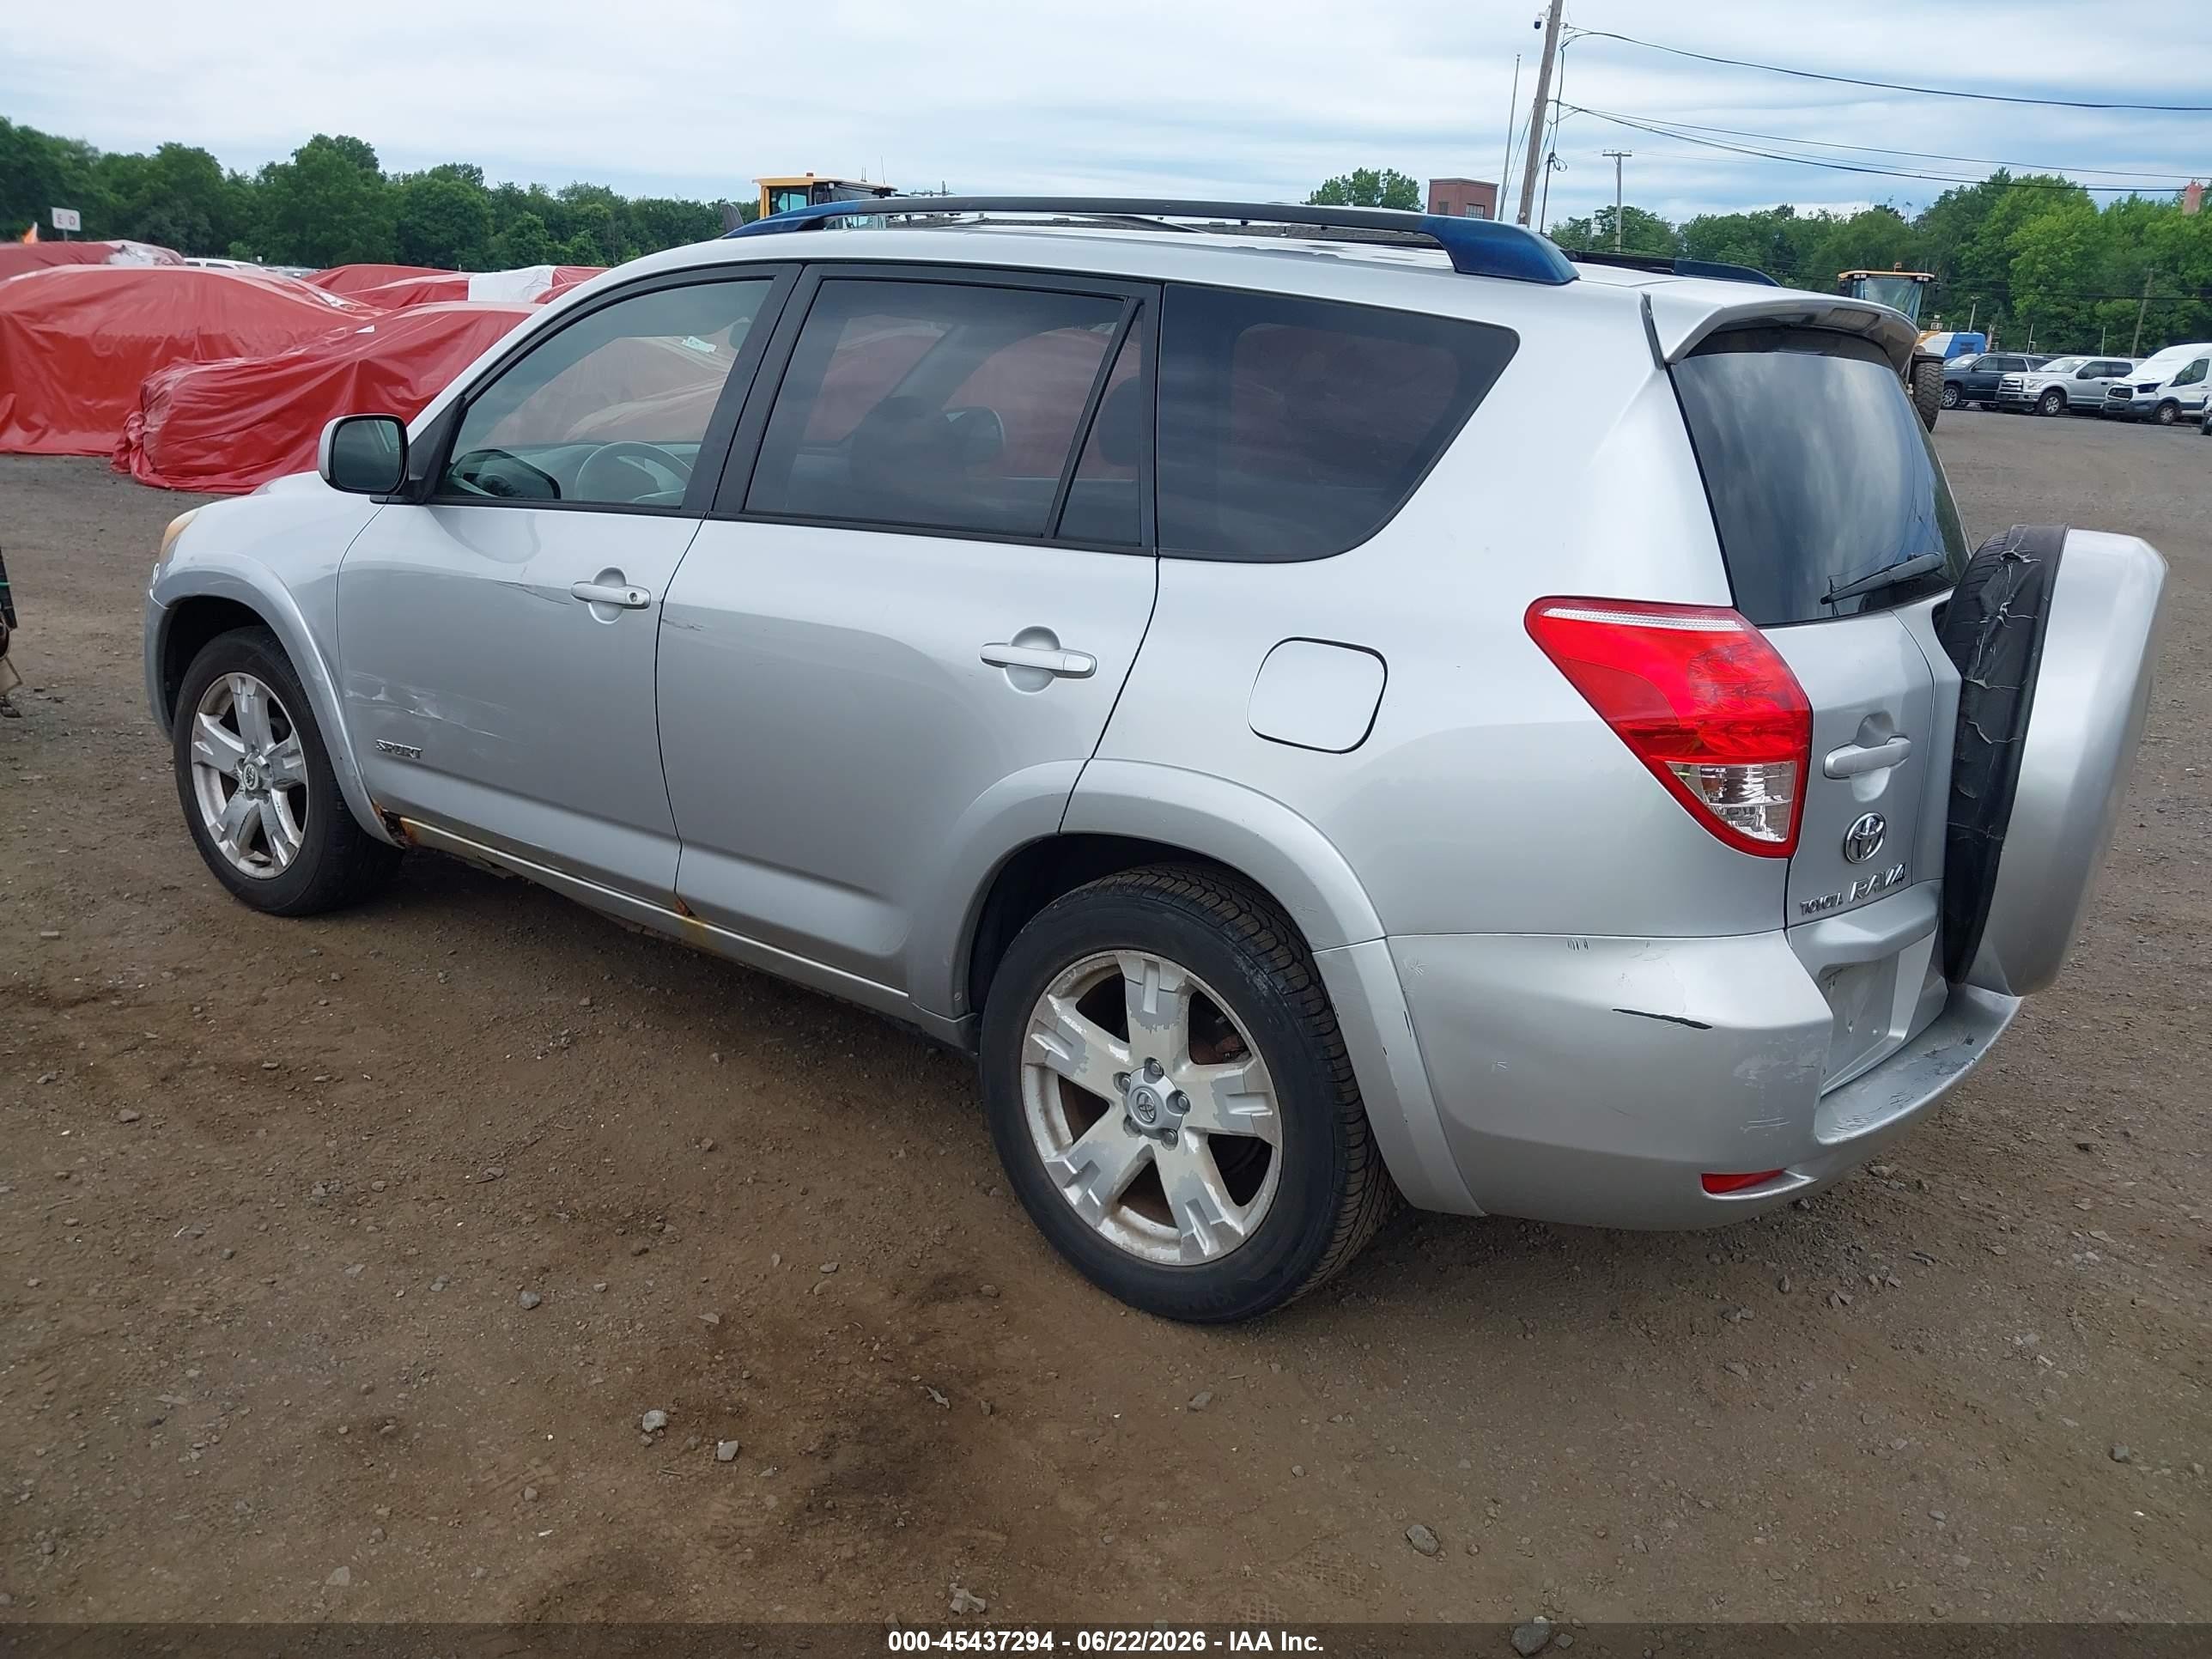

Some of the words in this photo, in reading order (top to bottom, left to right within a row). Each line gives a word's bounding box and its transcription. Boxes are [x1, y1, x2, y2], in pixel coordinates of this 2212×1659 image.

[375, 738, 422, 759] SPORT
[1800, 892, 1844, 915] TOYOTA
[1849, 863, 1905, 902] RAV4
